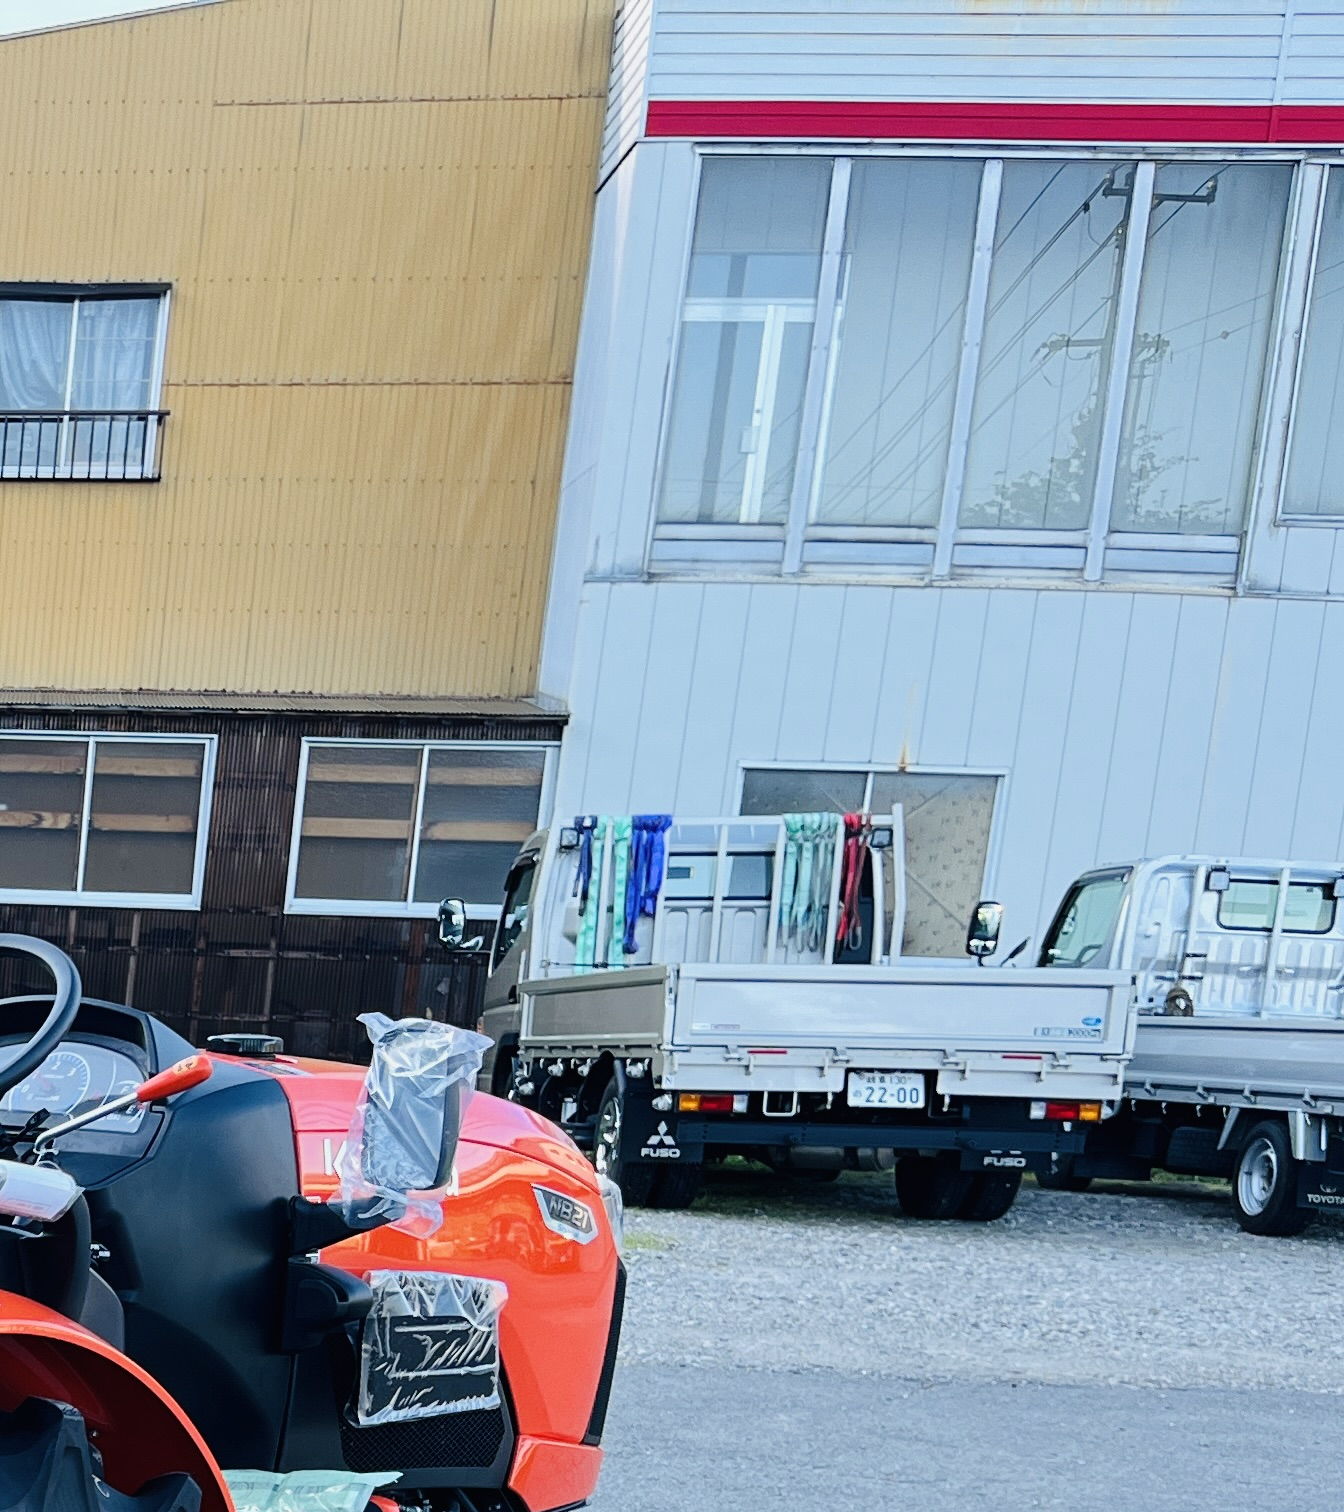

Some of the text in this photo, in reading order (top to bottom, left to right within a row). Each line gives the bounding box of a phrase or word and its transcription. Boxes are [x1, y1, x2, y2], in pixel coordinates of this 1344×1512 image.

[865, 1086, 919, 1104] 22-00
[640, 1147, 681, 1158] FUSO
[983, 1156, 1026, 1167] FUSO
[549, 1196, 589, 1229] NB21
